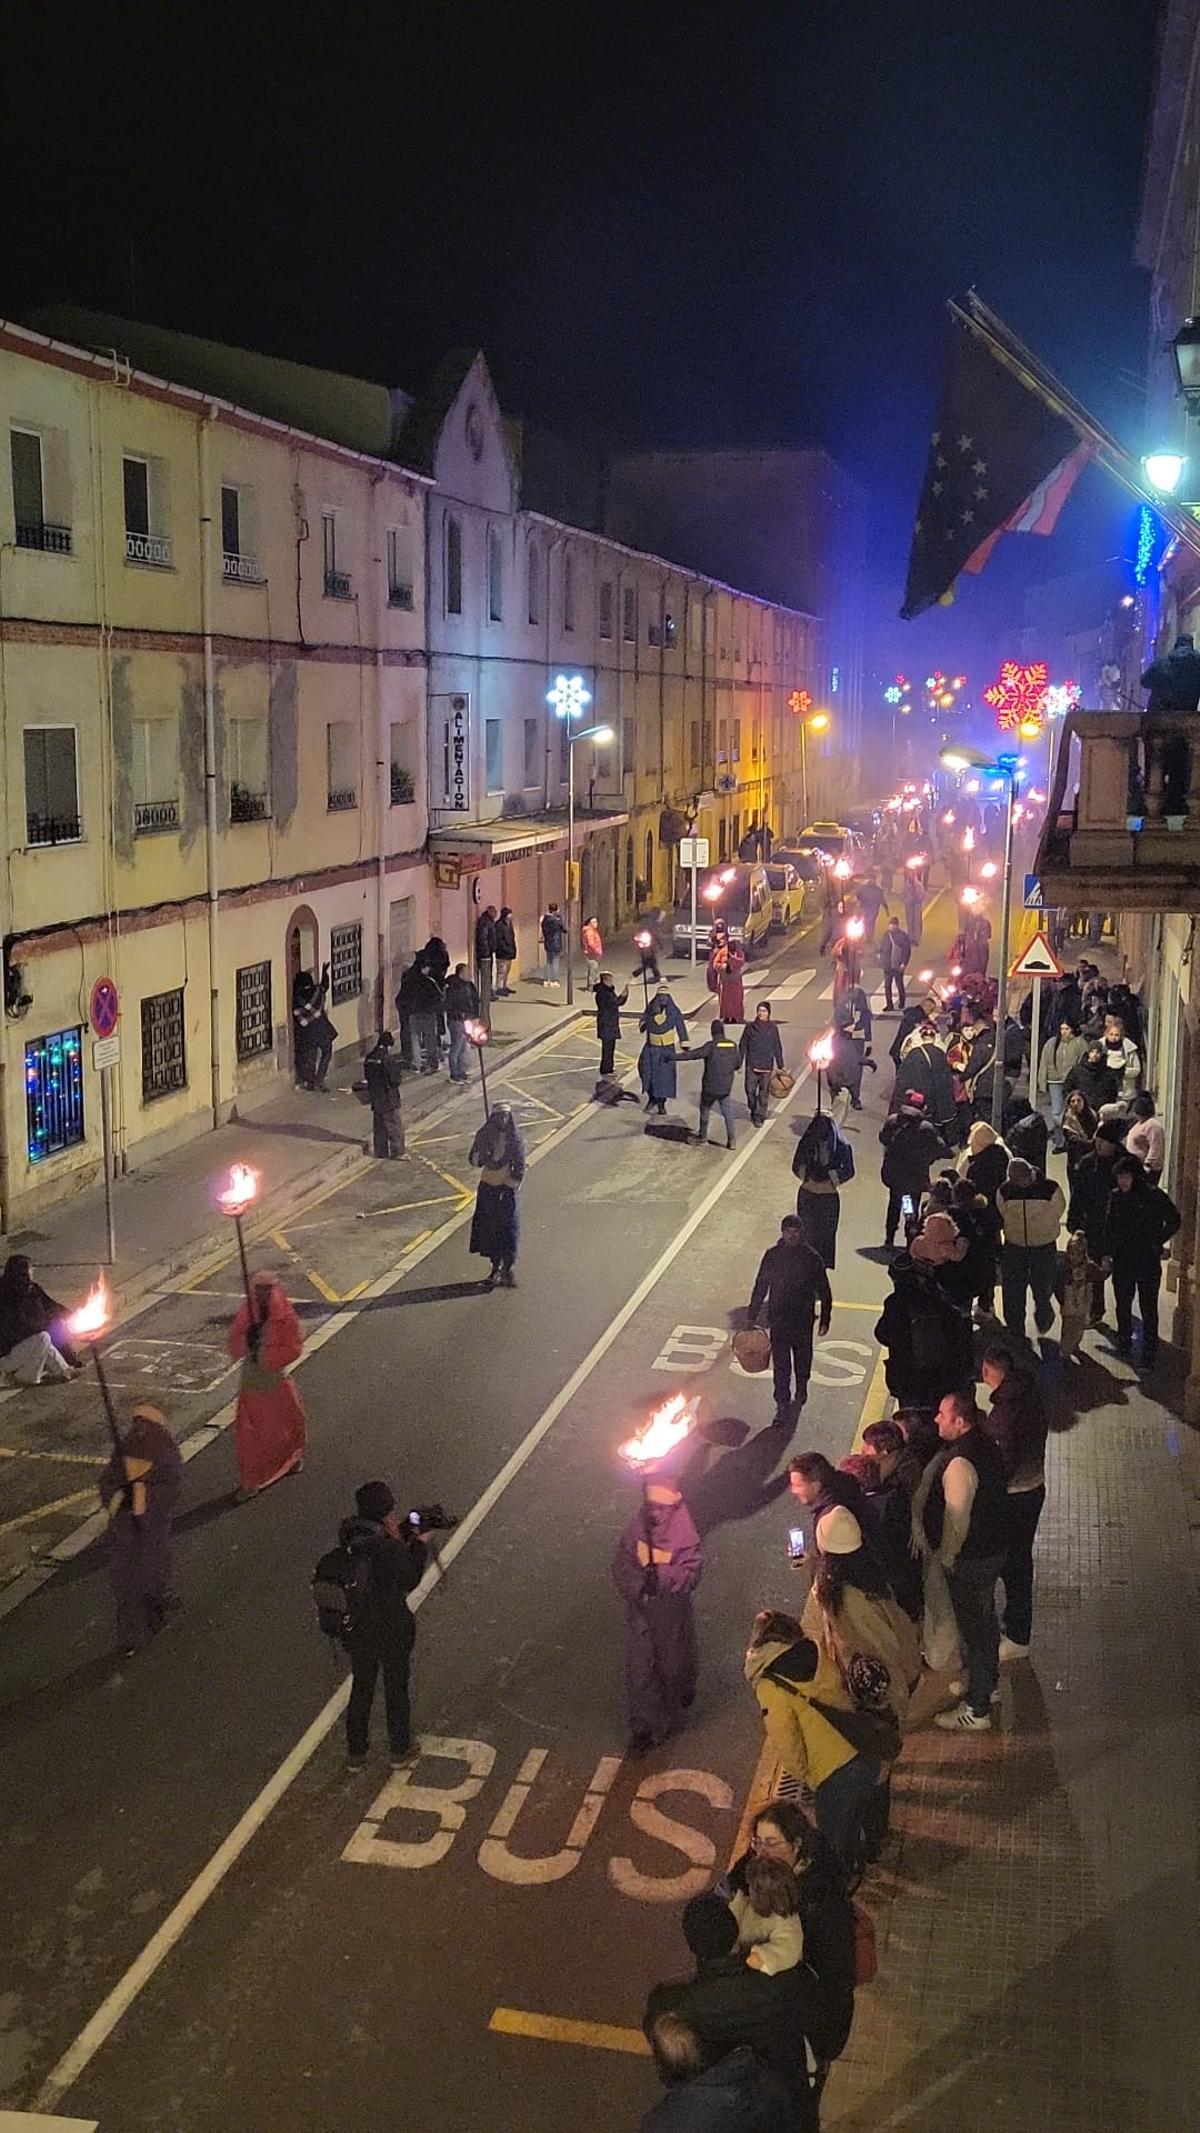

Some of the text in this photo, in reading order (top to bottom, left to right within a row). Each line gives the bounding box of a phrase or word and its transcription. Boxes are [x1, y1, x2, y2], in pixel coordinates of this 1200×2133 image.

[453, 712, 465, 808] ALIMENTACION
[651, 1324, 873, 1387] BS
[340, 1734, 734, 1903] BUS
